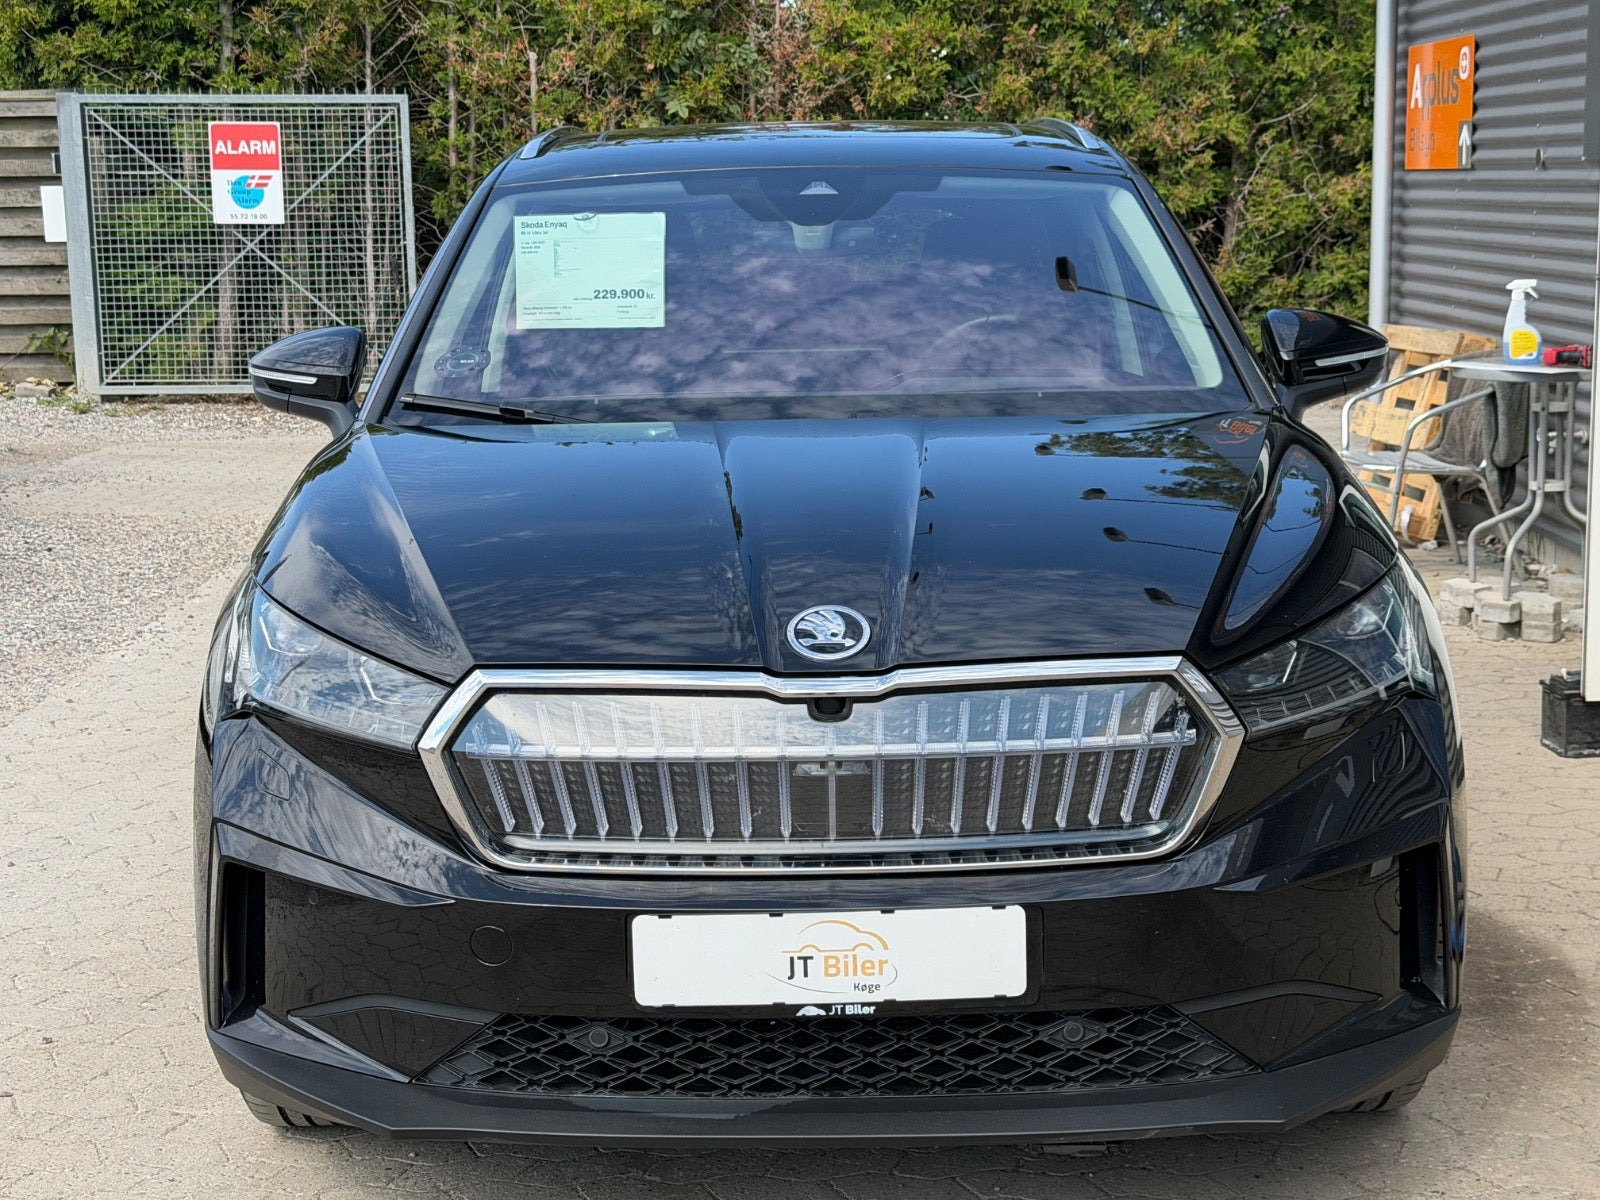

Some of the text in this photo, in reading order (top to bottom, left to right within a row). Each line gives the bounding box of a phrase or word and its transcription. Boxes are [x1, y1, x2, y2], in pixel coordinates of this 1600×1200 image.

[215, 140, 276, 155] ALARM
[236, 196, 260, 205] Alarm
[521, 221, 568, 229] Skoda Enyaq
[593, 288, 656, 300] 229.900 kr.
[787, 954, 889, 981] JT Biler
[853, 981, 881, 994] Køge
[829, 1003, 876, 1016] JT Biler
